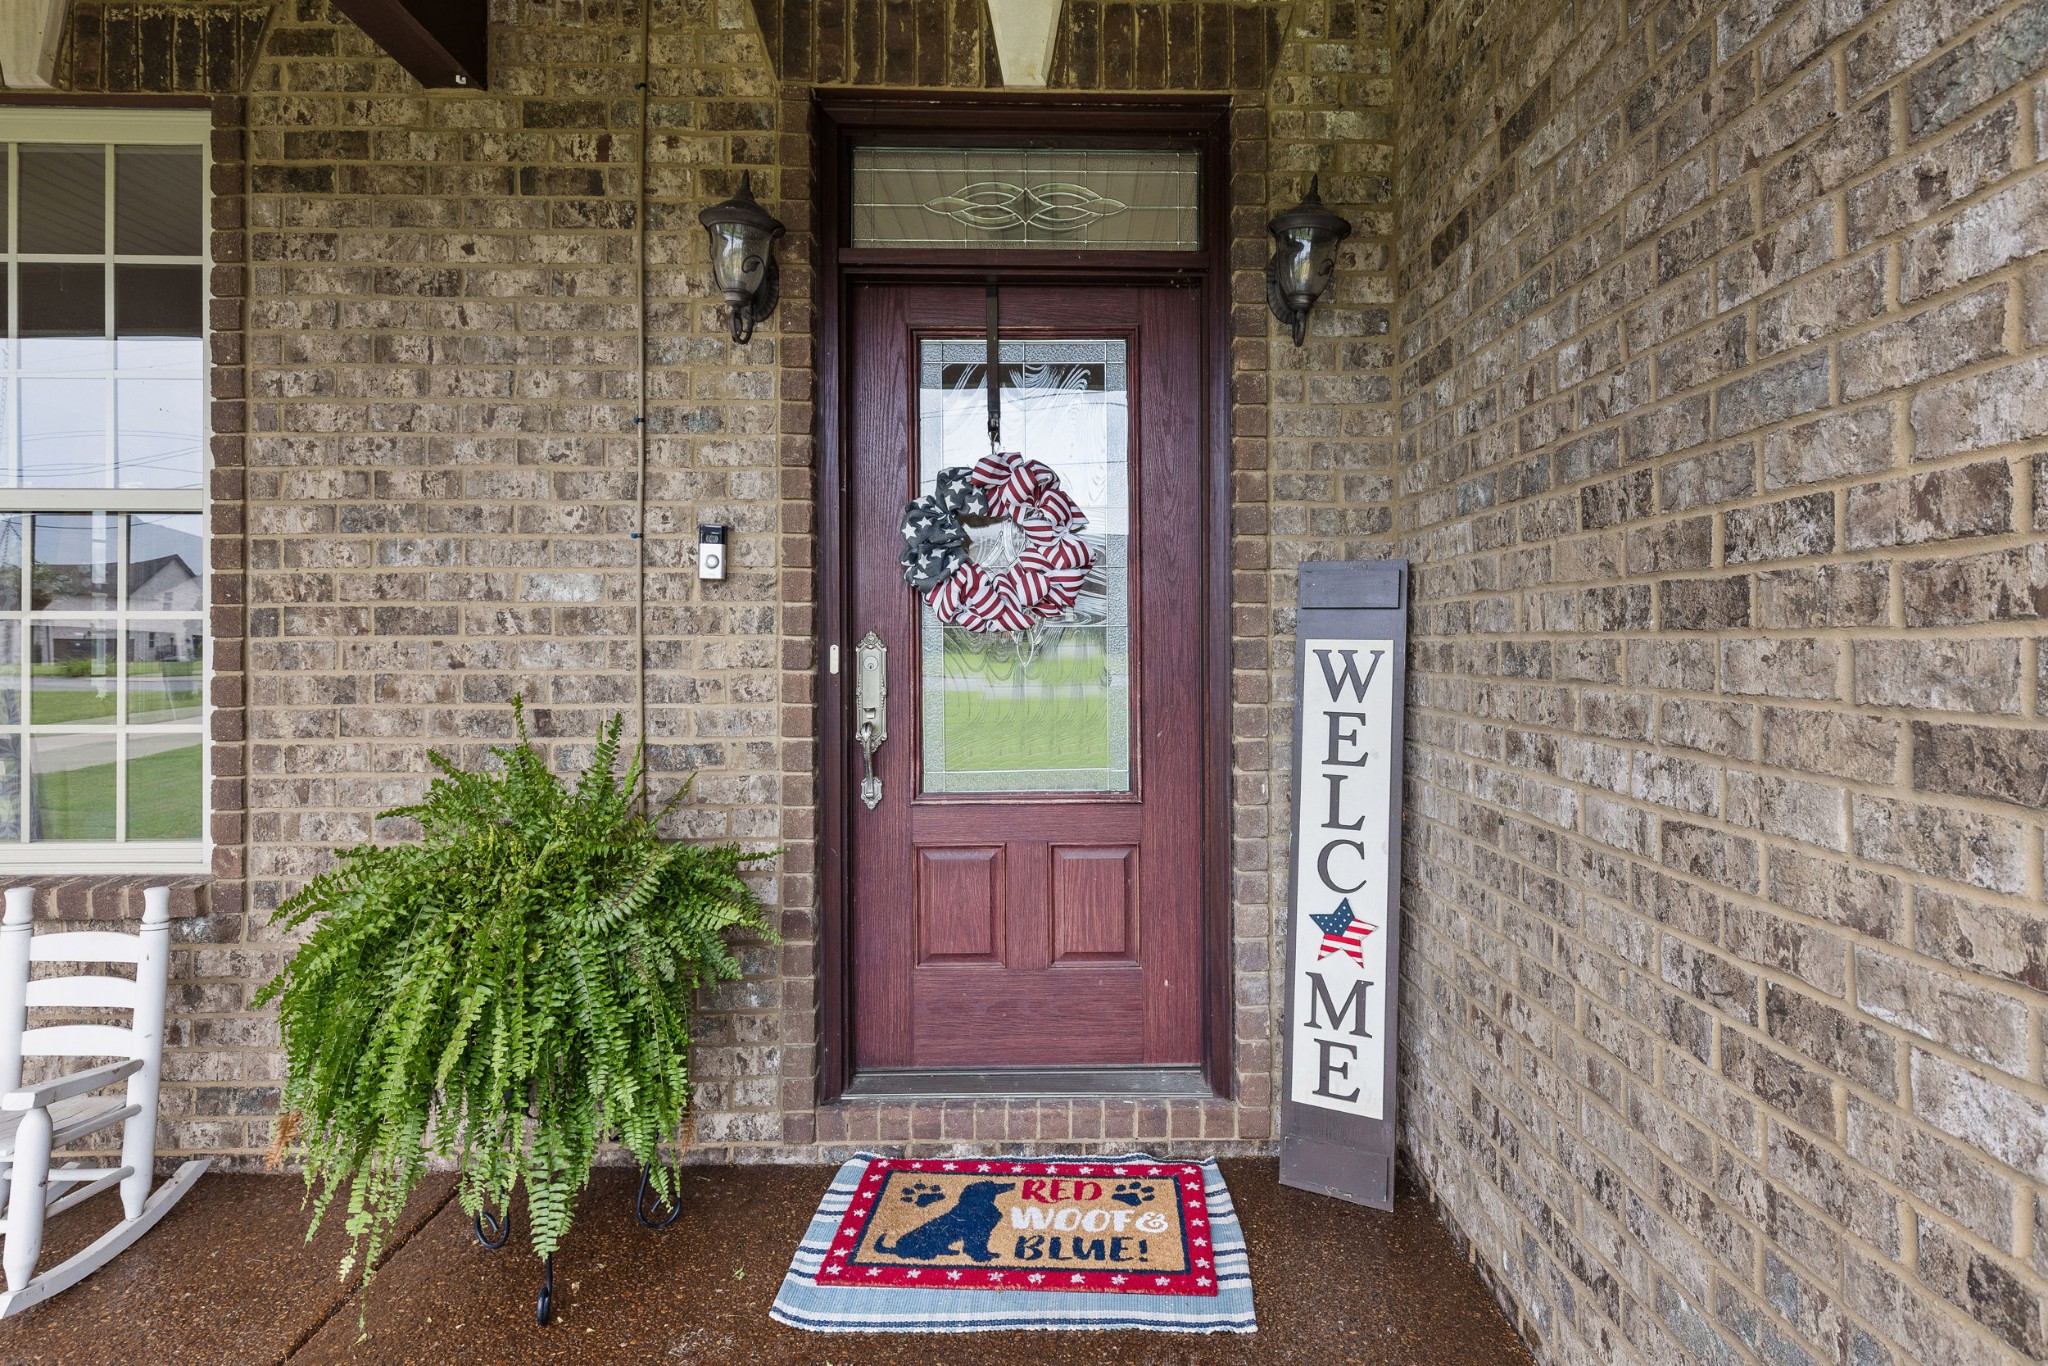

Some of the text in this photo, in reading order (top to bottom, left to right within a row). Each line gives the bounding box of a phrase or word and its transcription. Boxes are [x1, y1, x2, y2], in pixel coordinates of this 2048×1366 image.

[1304, 649, 1385, 1103] WELCME
[1021, 1179, 1103, 1204] RED
[1014, 1235, 1149, 1262] BLUE!
